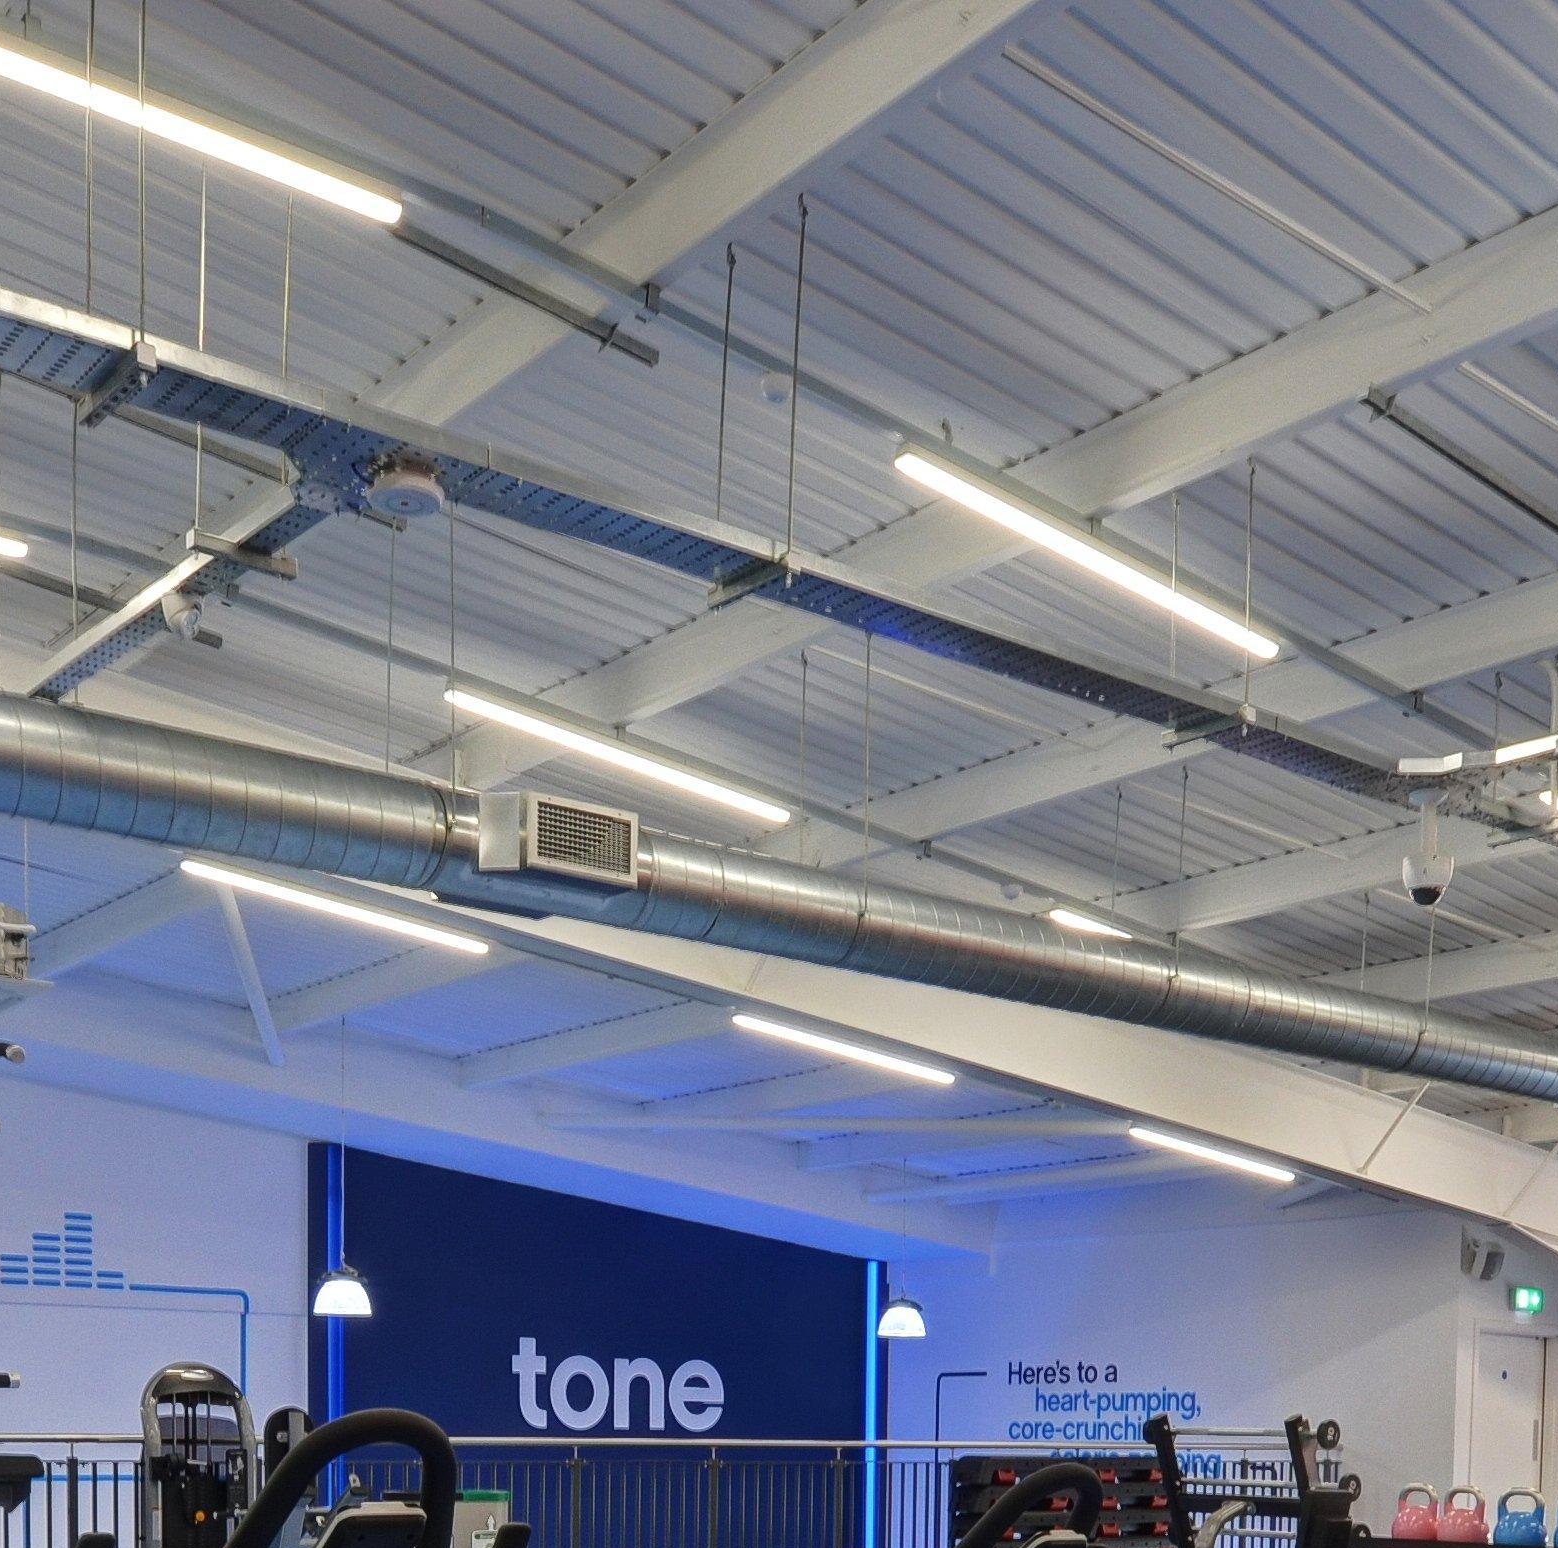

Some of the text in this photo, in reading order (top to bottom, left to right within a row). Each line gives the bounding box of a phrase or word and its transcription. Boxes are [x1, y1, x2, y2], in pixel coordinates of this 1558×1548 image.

[512, 1336, 725, 1432] tone
[1007, 1360, 1118, 1385] Here's to a
[1034, 1386, 1202, 1421] heart-pumping,
[1008, 1414, 1144, 1441] core-crunchi
